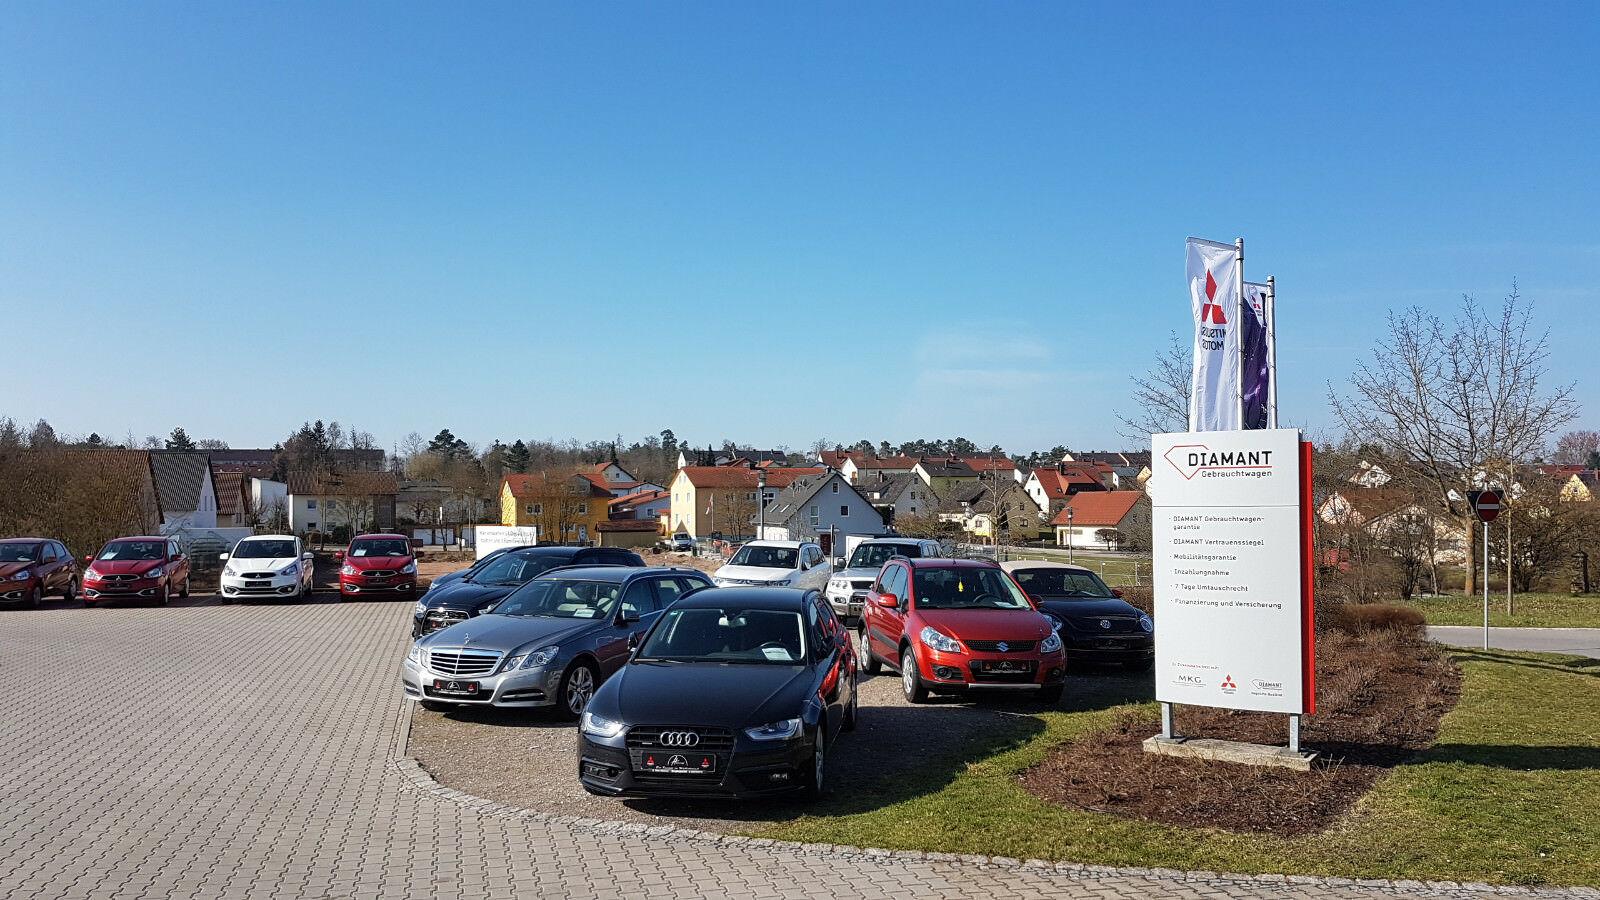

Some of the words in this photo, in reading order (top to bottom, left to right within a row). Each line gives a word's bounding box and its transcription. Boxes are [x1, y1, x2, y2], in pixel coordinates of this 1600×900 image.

[1188, 451, 1272, 466] DIAMANT
[1201, 470, 1272, 478] Gebrauchtwagen
[1204, 515, 1265, 524] Gebrauchtwagen-
[1204, 539, 1265, 547] Vertrauenssiegel
[1173, 553, 1237, 562] Mobilitätsgarantie
[1174, 569, 1230, 577] Inzahlungnahme
[1197, 584, 1249, 592] Umtauschrecht
[1174, 598, 1219, 607] Finanzierung
[1235, 601, 1282, 610] Versicherung
[1178, 675, 1201, 684] MKG
[1257, 681, 1283, 689] DIAMANT
